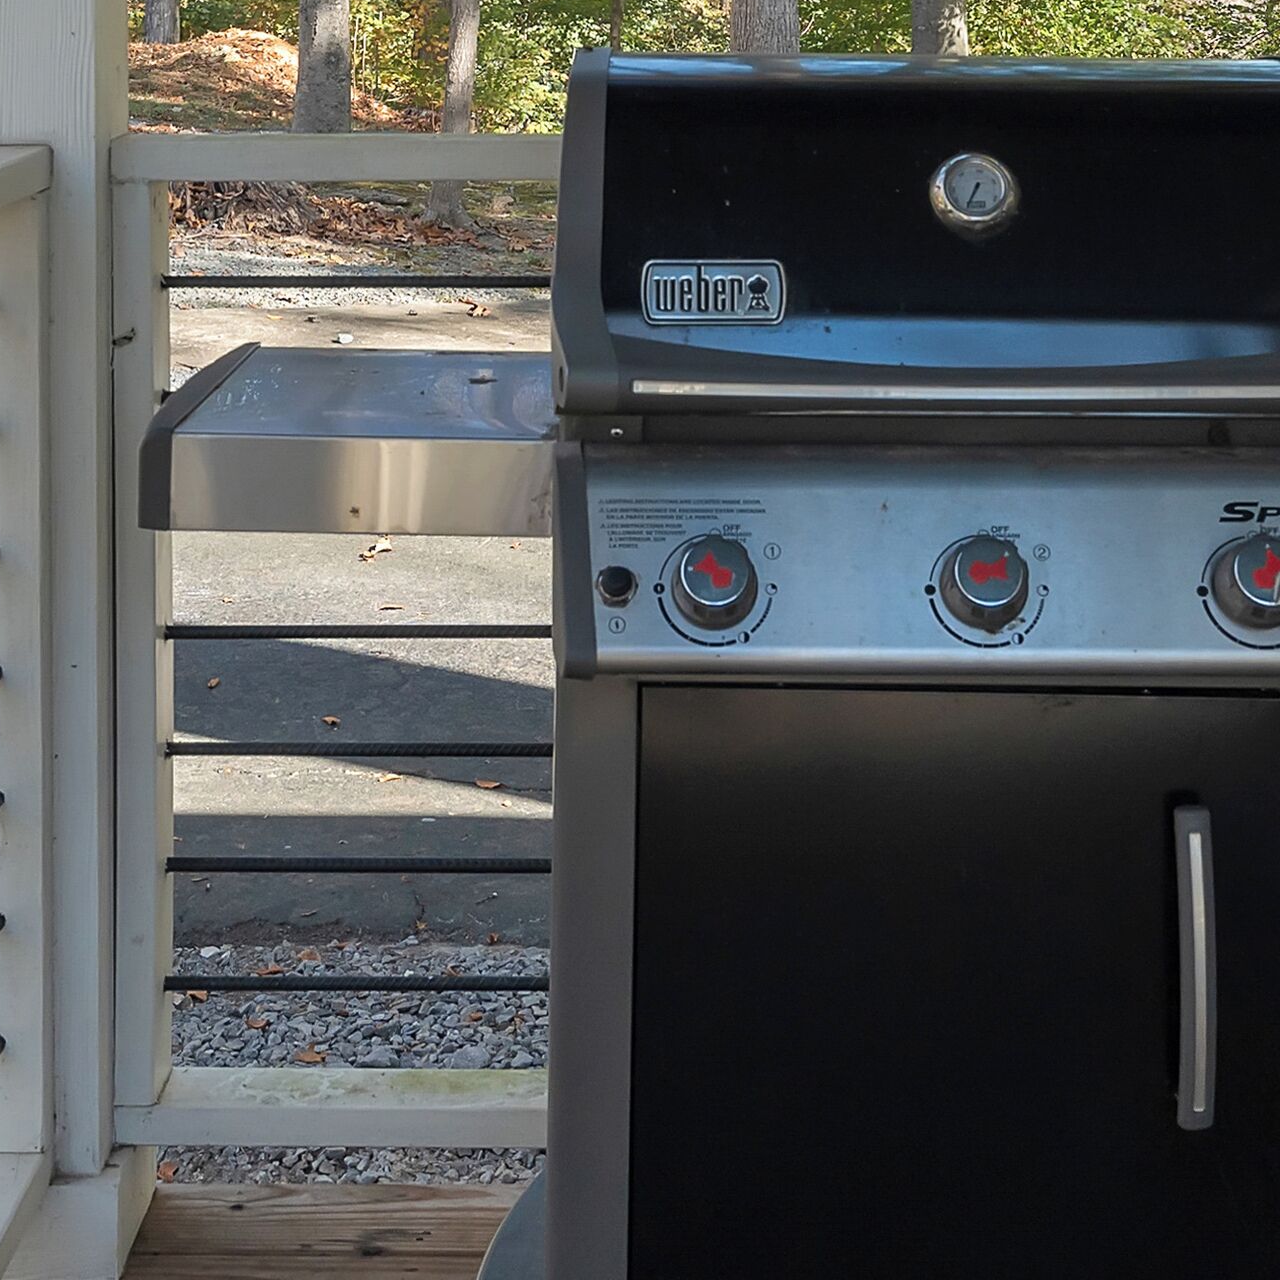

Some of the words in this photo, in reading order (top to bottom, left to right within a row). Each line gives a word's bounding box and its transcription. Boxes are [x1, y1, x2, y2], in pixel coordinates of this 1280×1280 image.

[651, 264, 745, 312] weber
[723, 524, 741, 532] OFF
[990, 525, 1010, 533] OFF
